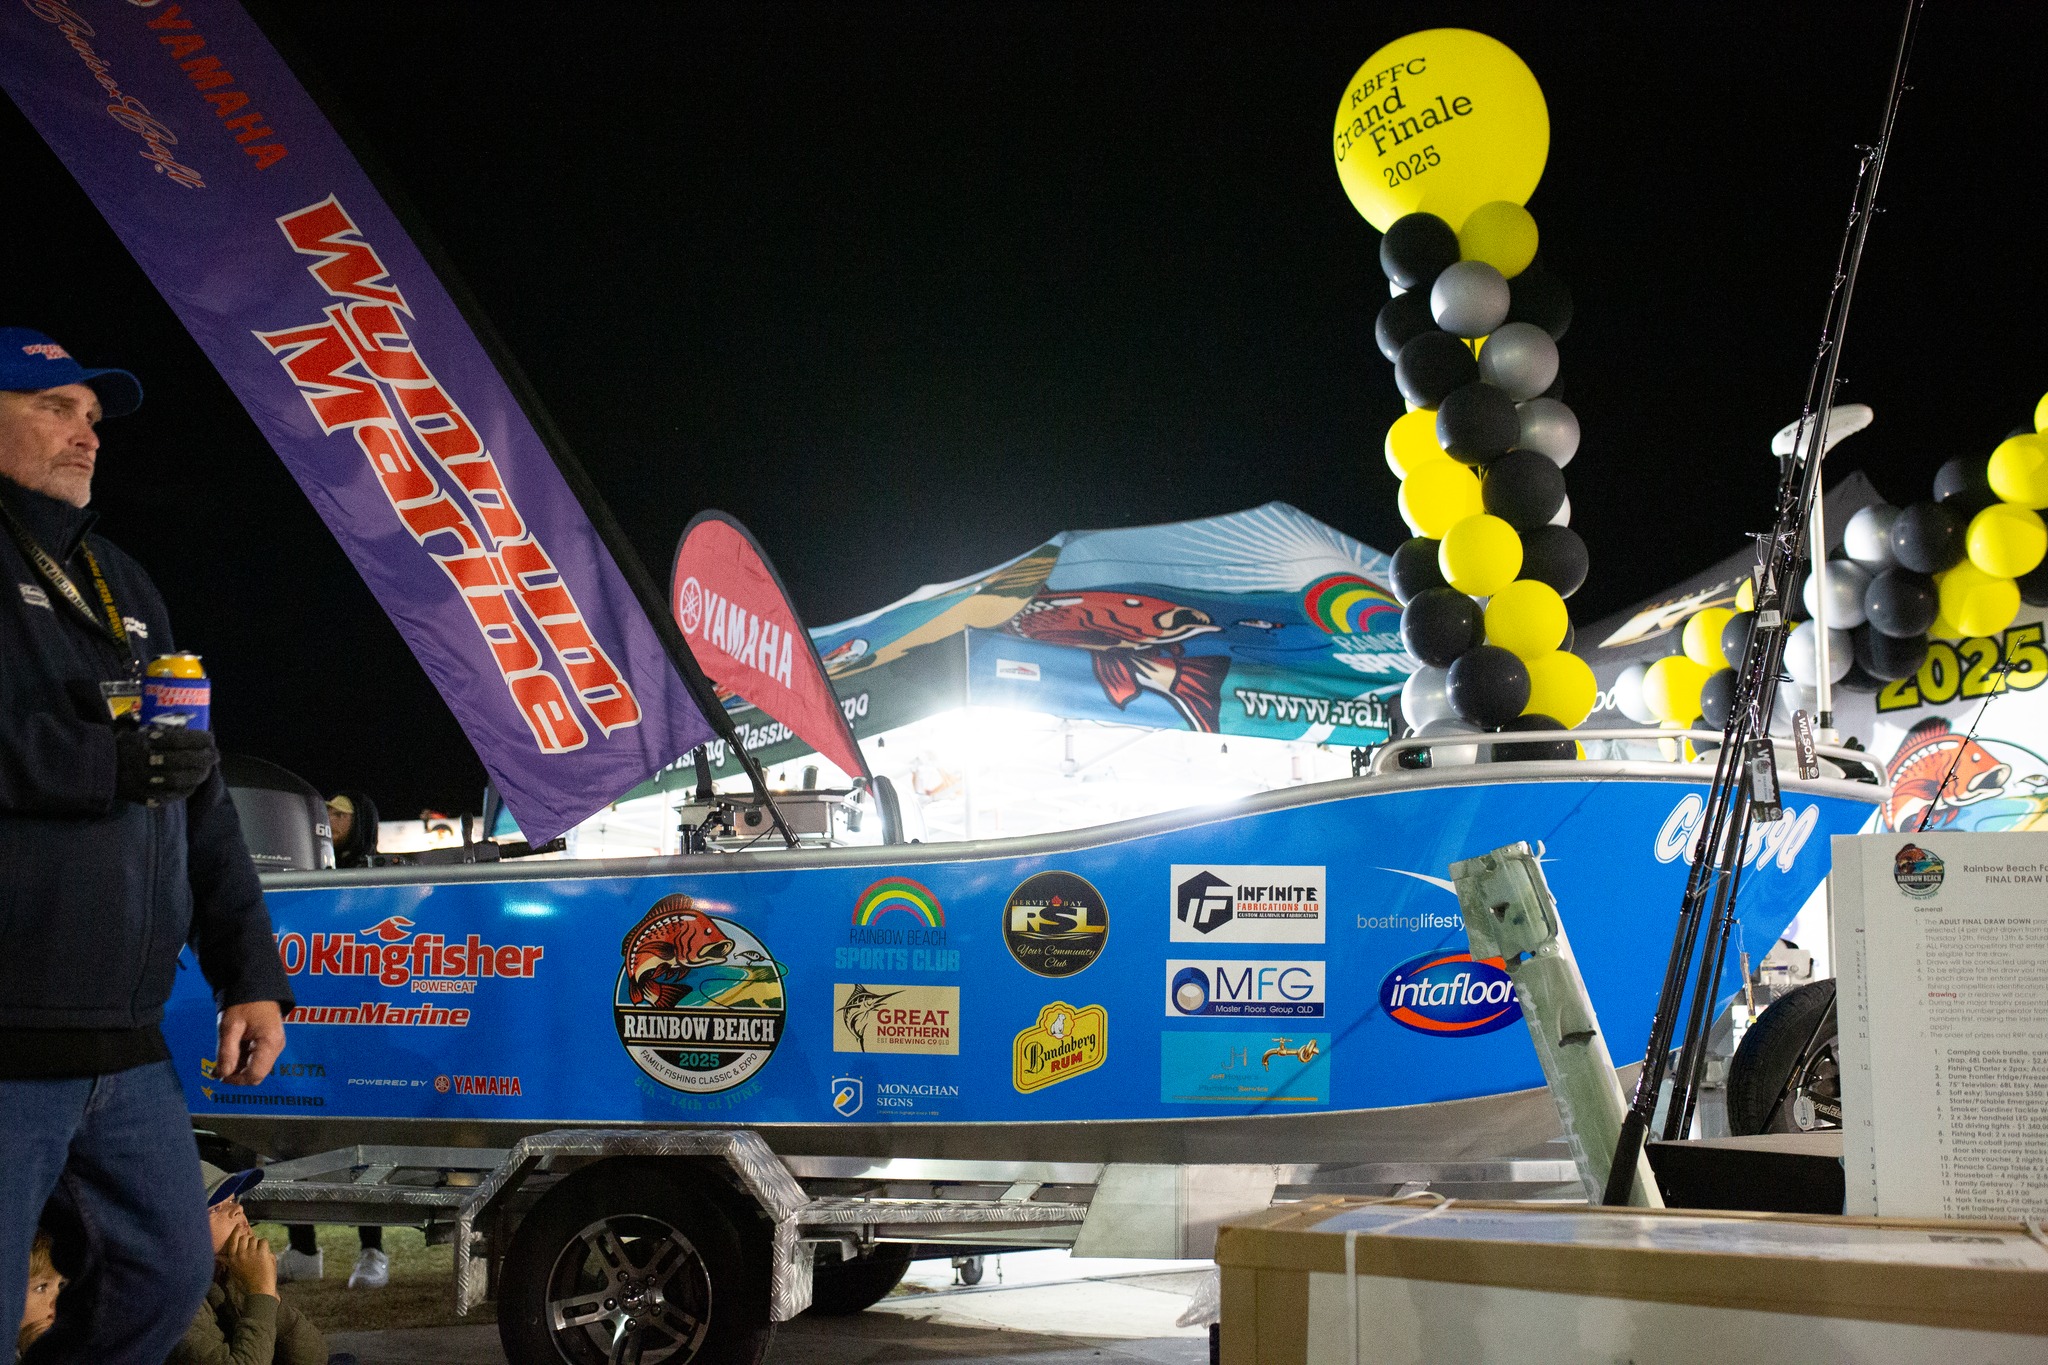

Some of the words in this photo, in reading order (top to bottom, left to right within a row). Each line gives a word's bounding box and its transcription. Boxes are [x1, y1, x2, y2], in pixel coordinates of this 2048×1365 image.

[146, 4, 289, 171] YAMAHA
[1351, 57, 1426, 110] RBFFC
[1335, 86, 1406, 162] Grand
[1369, 95, 1473, 157] Finale
[1383, 145, 1441, 188] 2025
[275, 193, 642, 739] Wynnum
[251, 302, 589, 754] Marine
[702, 588, 793, 690] YAMAHA
[1234, 688, 1388, 729] www.rai
[1798, 717, 1814, 764] WILSON
[1963, 864, 2004, 873] Rainbow
[2006, 864, 2037, 873] Beach
[1986, 876, 2012, 884] FINAL
[2014, 876, 2042, 884] DRAW
[1237, 884, 1319, 904] INFINITE
[1012, 899, 1051, 907] HERVEY
[1063, 899, 1083, 907] BAY
[1237, 902, 1299, 912] FABRICATIONS
[1303, 903, 1319, 912] QLD
[1011, 905, 1106, 933] RSL
[849, 928, 906, 945] RAINBOW
[907, 930, 947, 946] BEACH
[1017, 943, 1042, 957] Your
[1044, 943, 1097, 959] Community
[308, 932, 544, 988] Kingfisher
[835, 946, 909, 971] SPORTS
[912, 948, 960, 971] CLUB
[1044, 956, 1067, 969] Club
[410, 980, 477, 994] POWERCAT
[1215, 966, 1314, 1001] MFG
[1928, 991, 1957, 999] drawing
[1215, 1004, 1241, 1013] Master
[1244, 1004, 1266, 1013] Floors
[1269, 1005, 1293, 1015] Group
[1297, 1005, 1314, 1014] QLD
[876, 1008, 950, 1026] GREAT
[623, 1015, 710, 1041] RAINBOW
[712, 1018, 775, 1042] BEACH
[876, 1026, 950, 1038] NORTHERN
[889, 1038, 926, 1046] BREWING
[1023, 1032, 1096, 1075] Bundaberg
[1947, 1048, 1981, 1057] Camping
[640, 1049, 664, 1073] FAMILY
[664, 1068, 697, 1085] FISHING
[698, 1070, 733, 1085] CLASSIC
[732, 1067, 740, 1076] &
[740, 1052, 758, 1072] EXPO
[680, 1053, 720, 1068] 2025
[1050, 1050, 1083, 1074] RUM
[2009, 1057, 2025, 1066] Esky
[1947, 1064, 1972, 1073] Fishing
[1973, 1064, 2000, 1072] Charter
[347, 1078, 408, 1087] POWERED
[410, 1079, 428, 1087] BY
[1948, 1072, 1967, 1080] Dune
[452, 1075, 522, 1096] YAMAHA
[876, 1084, 959, 1097] MONAGHAN
[1949, 1089, 1962, 1097] Soft
[1984, 1090, 2024, 1099] Sunglasses
[876, 1097, 914, 1108] SIGNS
[1949, 1097, 2005, 1106] Starter/Portable
[2014, 1106, 2039, 1114] Tackle
[2015, 1114, 2028, 1122] LED
[1951, 1121, 1963, 1129] LED
[1965, 1121, 1989, 1130] driving
[1991, 1122, 2010, 1131] lights
[1953, 1171, 1994, 1179] Houseboat
[1955, 1187, 1970, 1195] Mini
[1971, 1187, 1987, 1195] Golf
